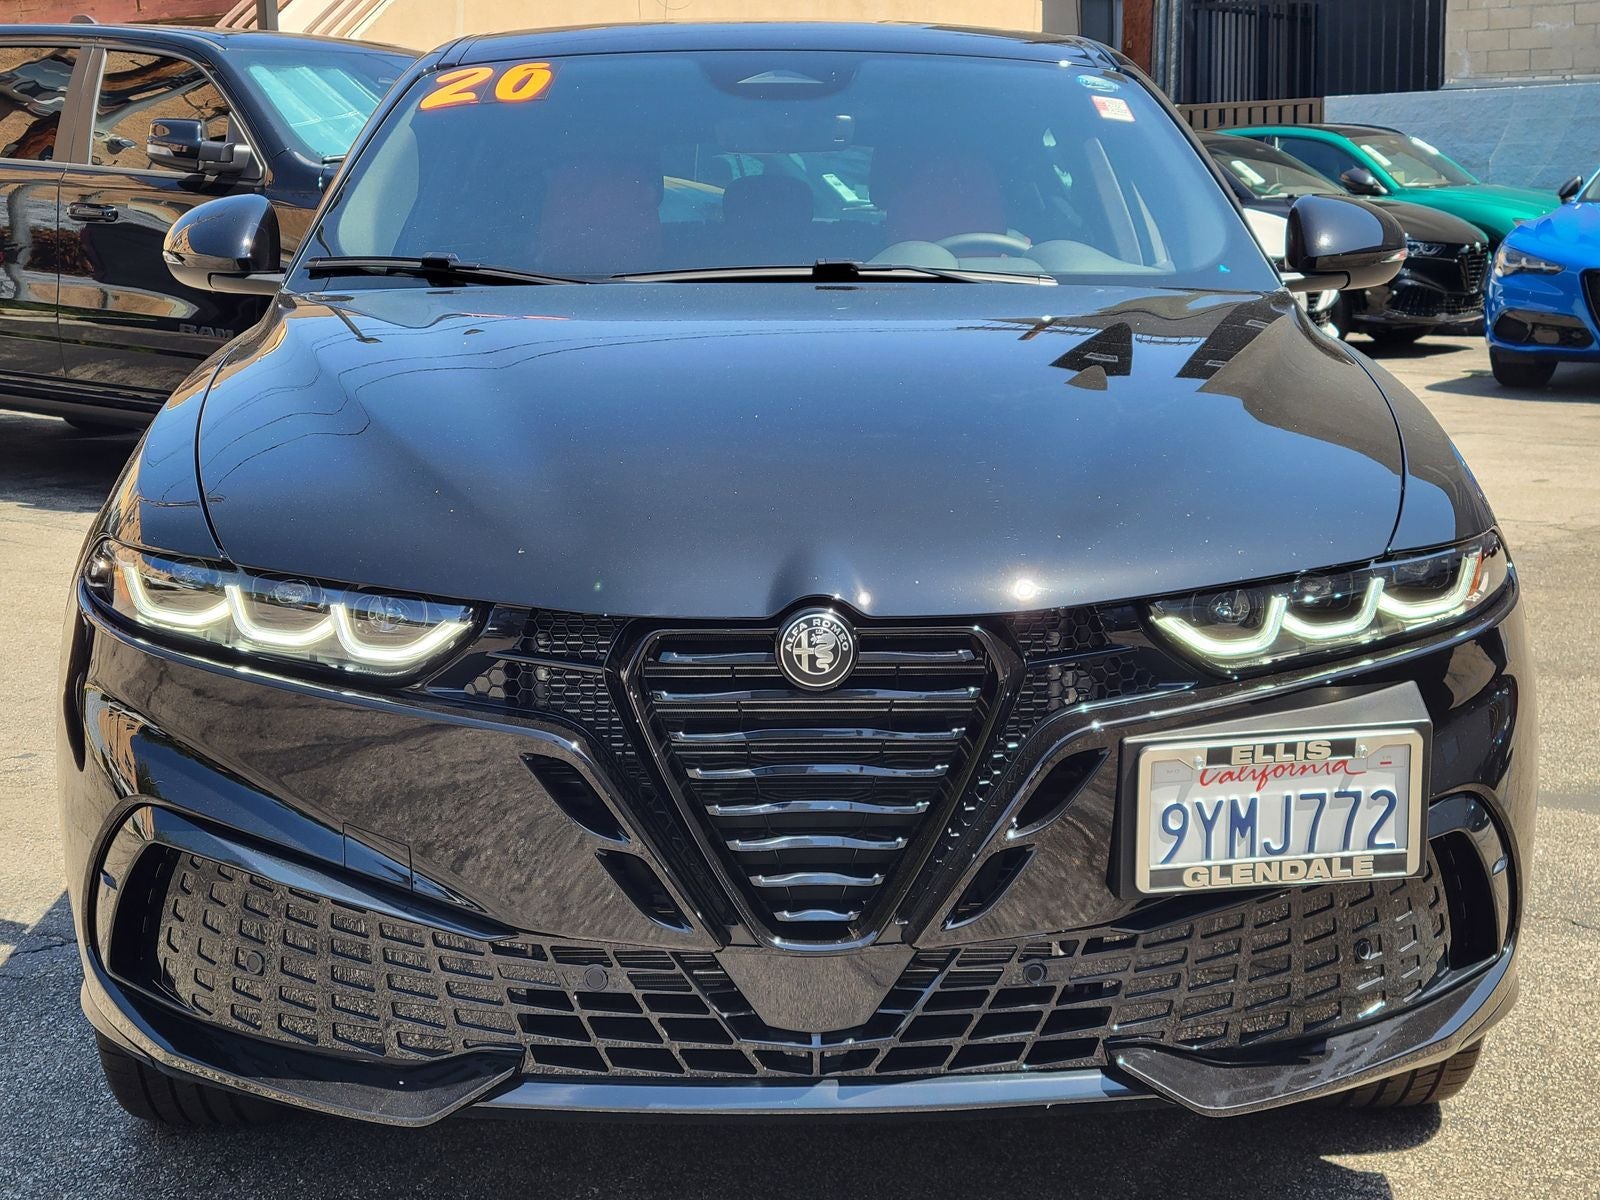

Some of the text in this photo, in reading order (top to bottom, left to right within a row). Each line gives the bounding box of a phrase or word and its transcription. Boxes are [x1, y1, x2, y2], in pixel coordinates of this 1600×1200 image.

[419, 62, 553, 111] 26
[179, 323, 234, 340] RAM
[785, 618, 849, 652] ALFA ROMEO
[1231, 740, 1332, 766] ELLIS
[1199, 759, 1366, 792] California
[1160, 789, 1398, 865] 9YMJ772
[1183, 856, 1375, 888] GLENDALE
